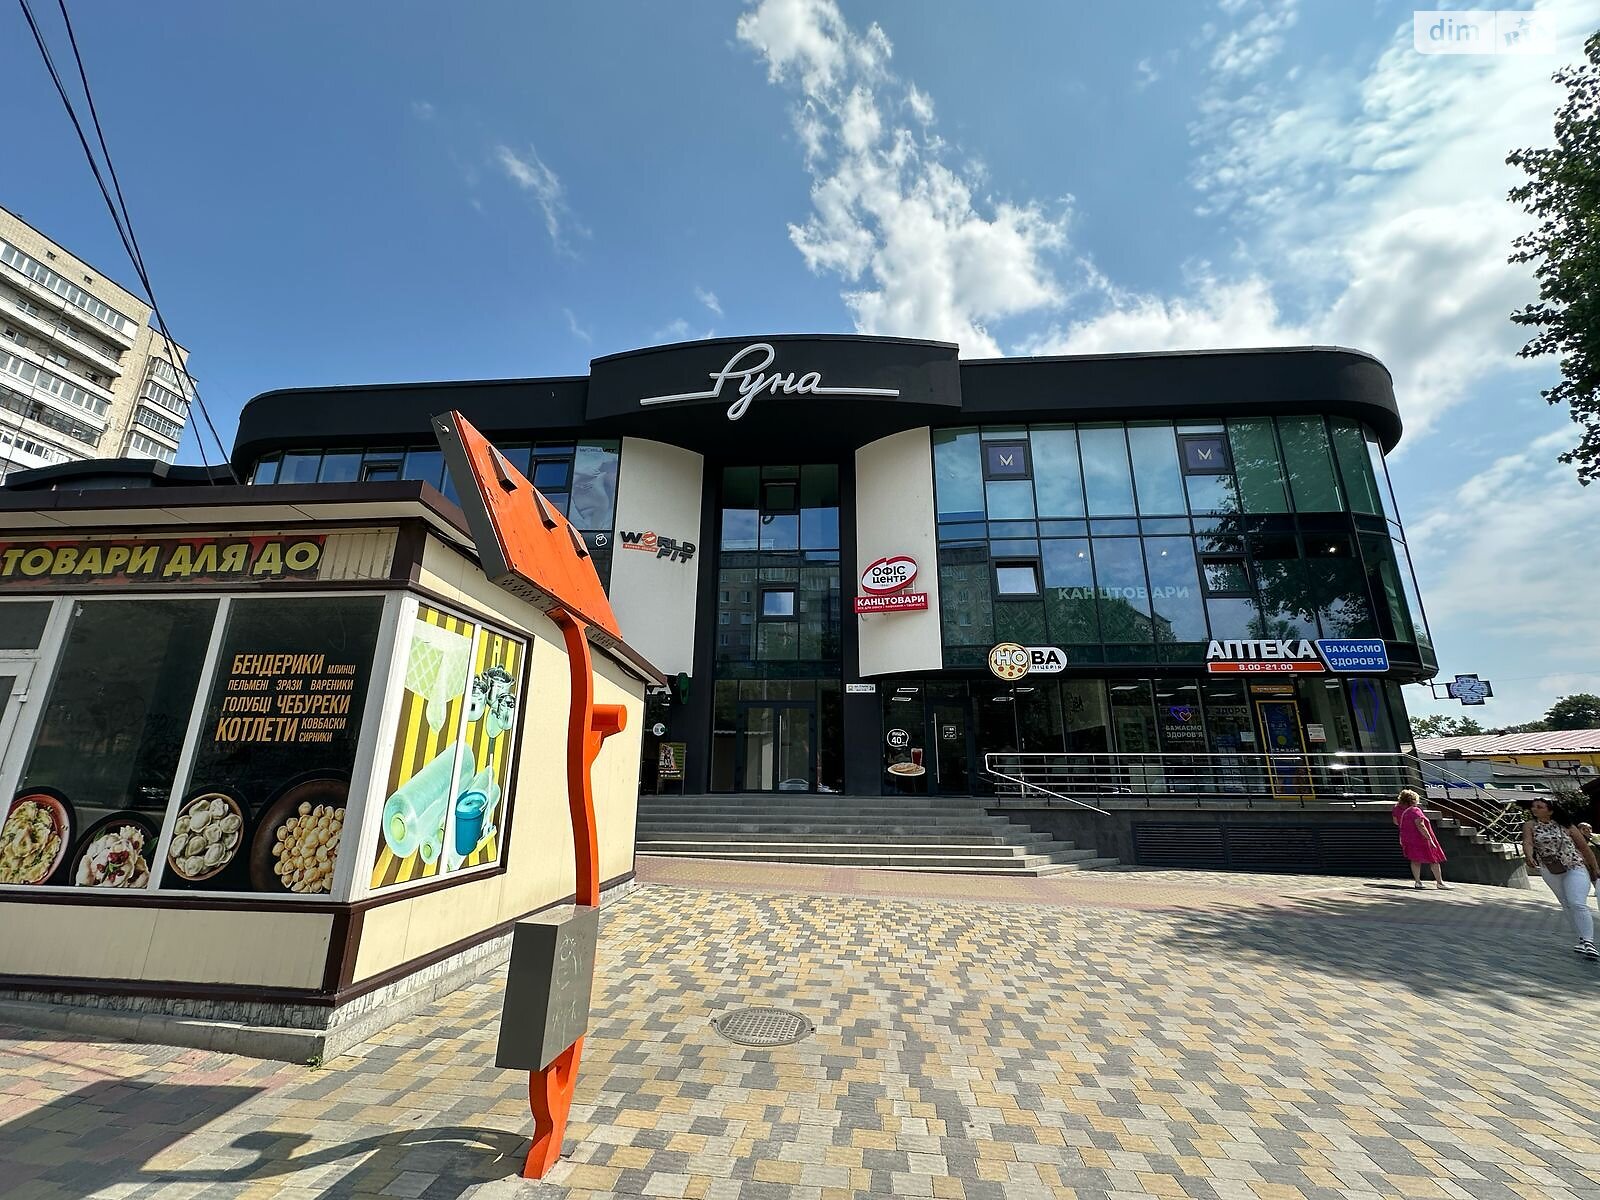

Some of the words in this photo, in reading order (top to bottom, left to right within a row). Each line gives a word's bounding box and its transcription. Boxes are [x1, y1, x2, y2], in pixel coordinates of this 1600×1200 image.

[620, 530, 696, 554] WORLD
[2, 546, 160, 576] ТОВАРИ
[163, 543, 248, 577] ДЛЯ
[656, 547, 693, 563] FIT
[872, 566, 906, 576] ОФІС
[1058, 586, 1190, 600] КАНЦТОВАРИ
[857, 595, 925, 607] КАНЦТОВАРИ
[1206, 639, 1318, 659] АПТЕКА
[1325, 645, 1382, 653] БАЖАЄМО
[996, 650, 1061, 665] НОВА
[1331, 657, 1385, 667] ЗДОРОВ'Я
[231, 654, 325, 677] БЕНДЕРИКИ
[326, 665, 356, 675] МЛИНЦІ
[227, 680, 269, 690] ПЕЛЬМЕНІ
[276, 680, 303, 690] ЗРАЗИ
[310, 680, 354, 690] ВАРЕНИКИ
[222, 697, 272, 713] ГОЛУБЦІ
[277, 695, 351, 714] ЧЕБУРЕКИ
[214, 717, 300, 742] КОТЛЕТИ
[301, 718, 346, 729] КОВБАСКИ
[298, 732, 333, 742] СИРНИКИ
